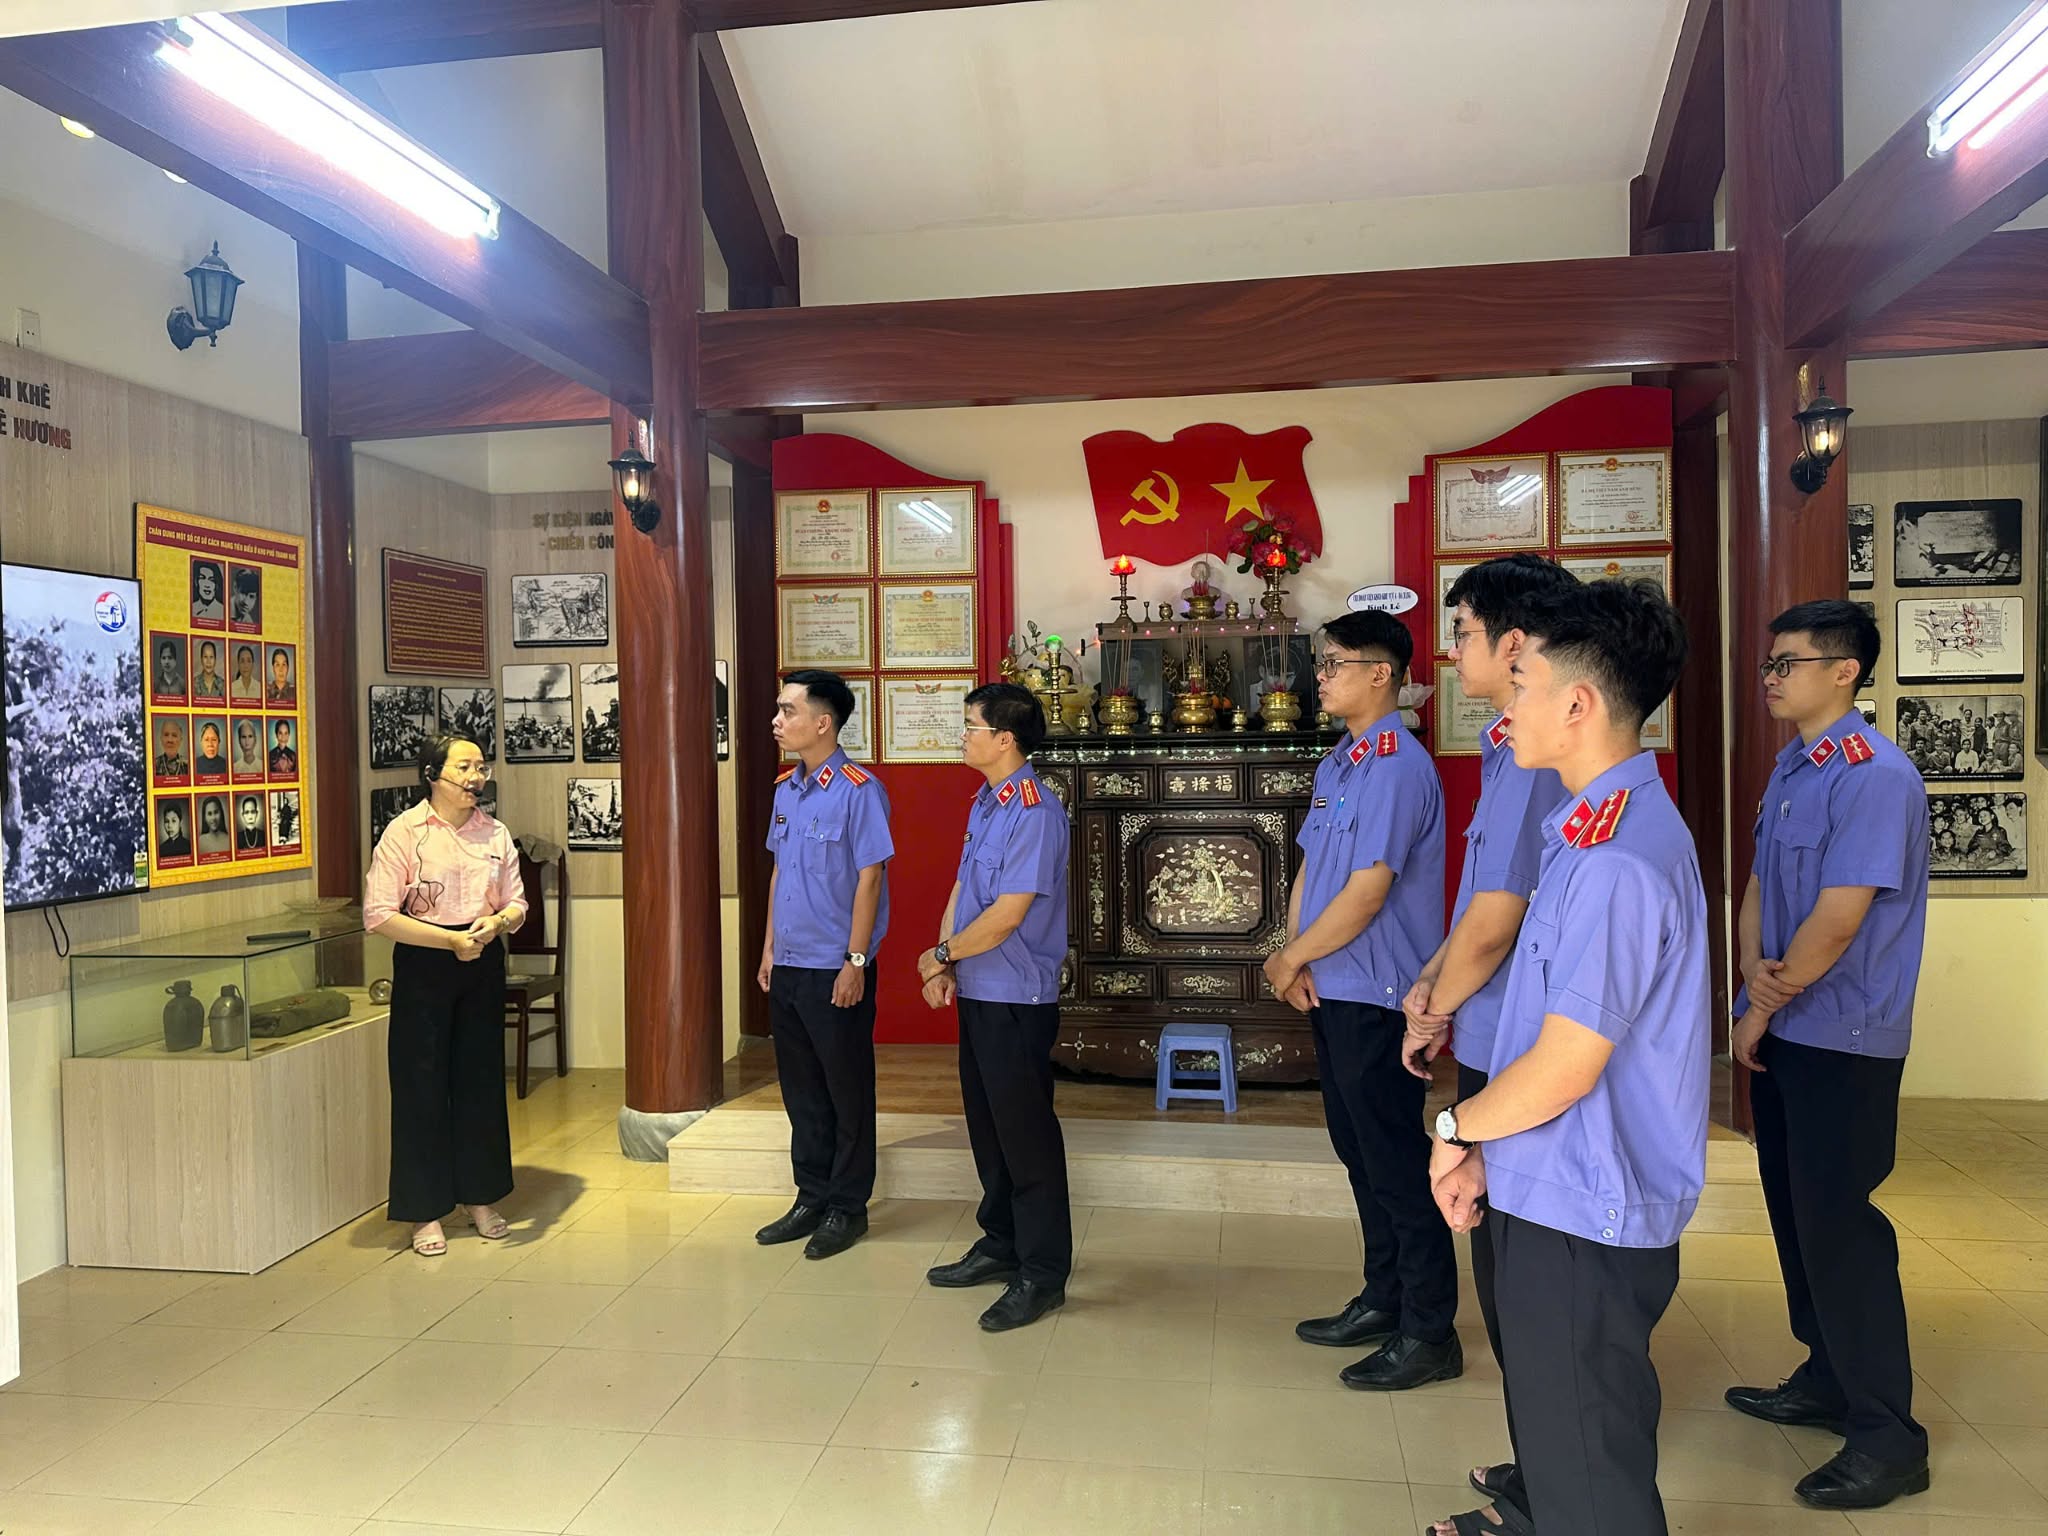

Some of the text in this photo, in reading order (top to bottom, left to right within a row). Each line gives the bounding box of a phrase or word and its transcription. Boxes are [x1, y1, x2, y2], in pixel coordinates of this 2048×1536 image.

[17, 381, 50, 409] KHÊ
[14, 417, 72, 450] HƯƠNG
[533, 508, 614, 531] SỰ KIỆN NGÀ
[548, 530, 584, 550] CHIẾN
